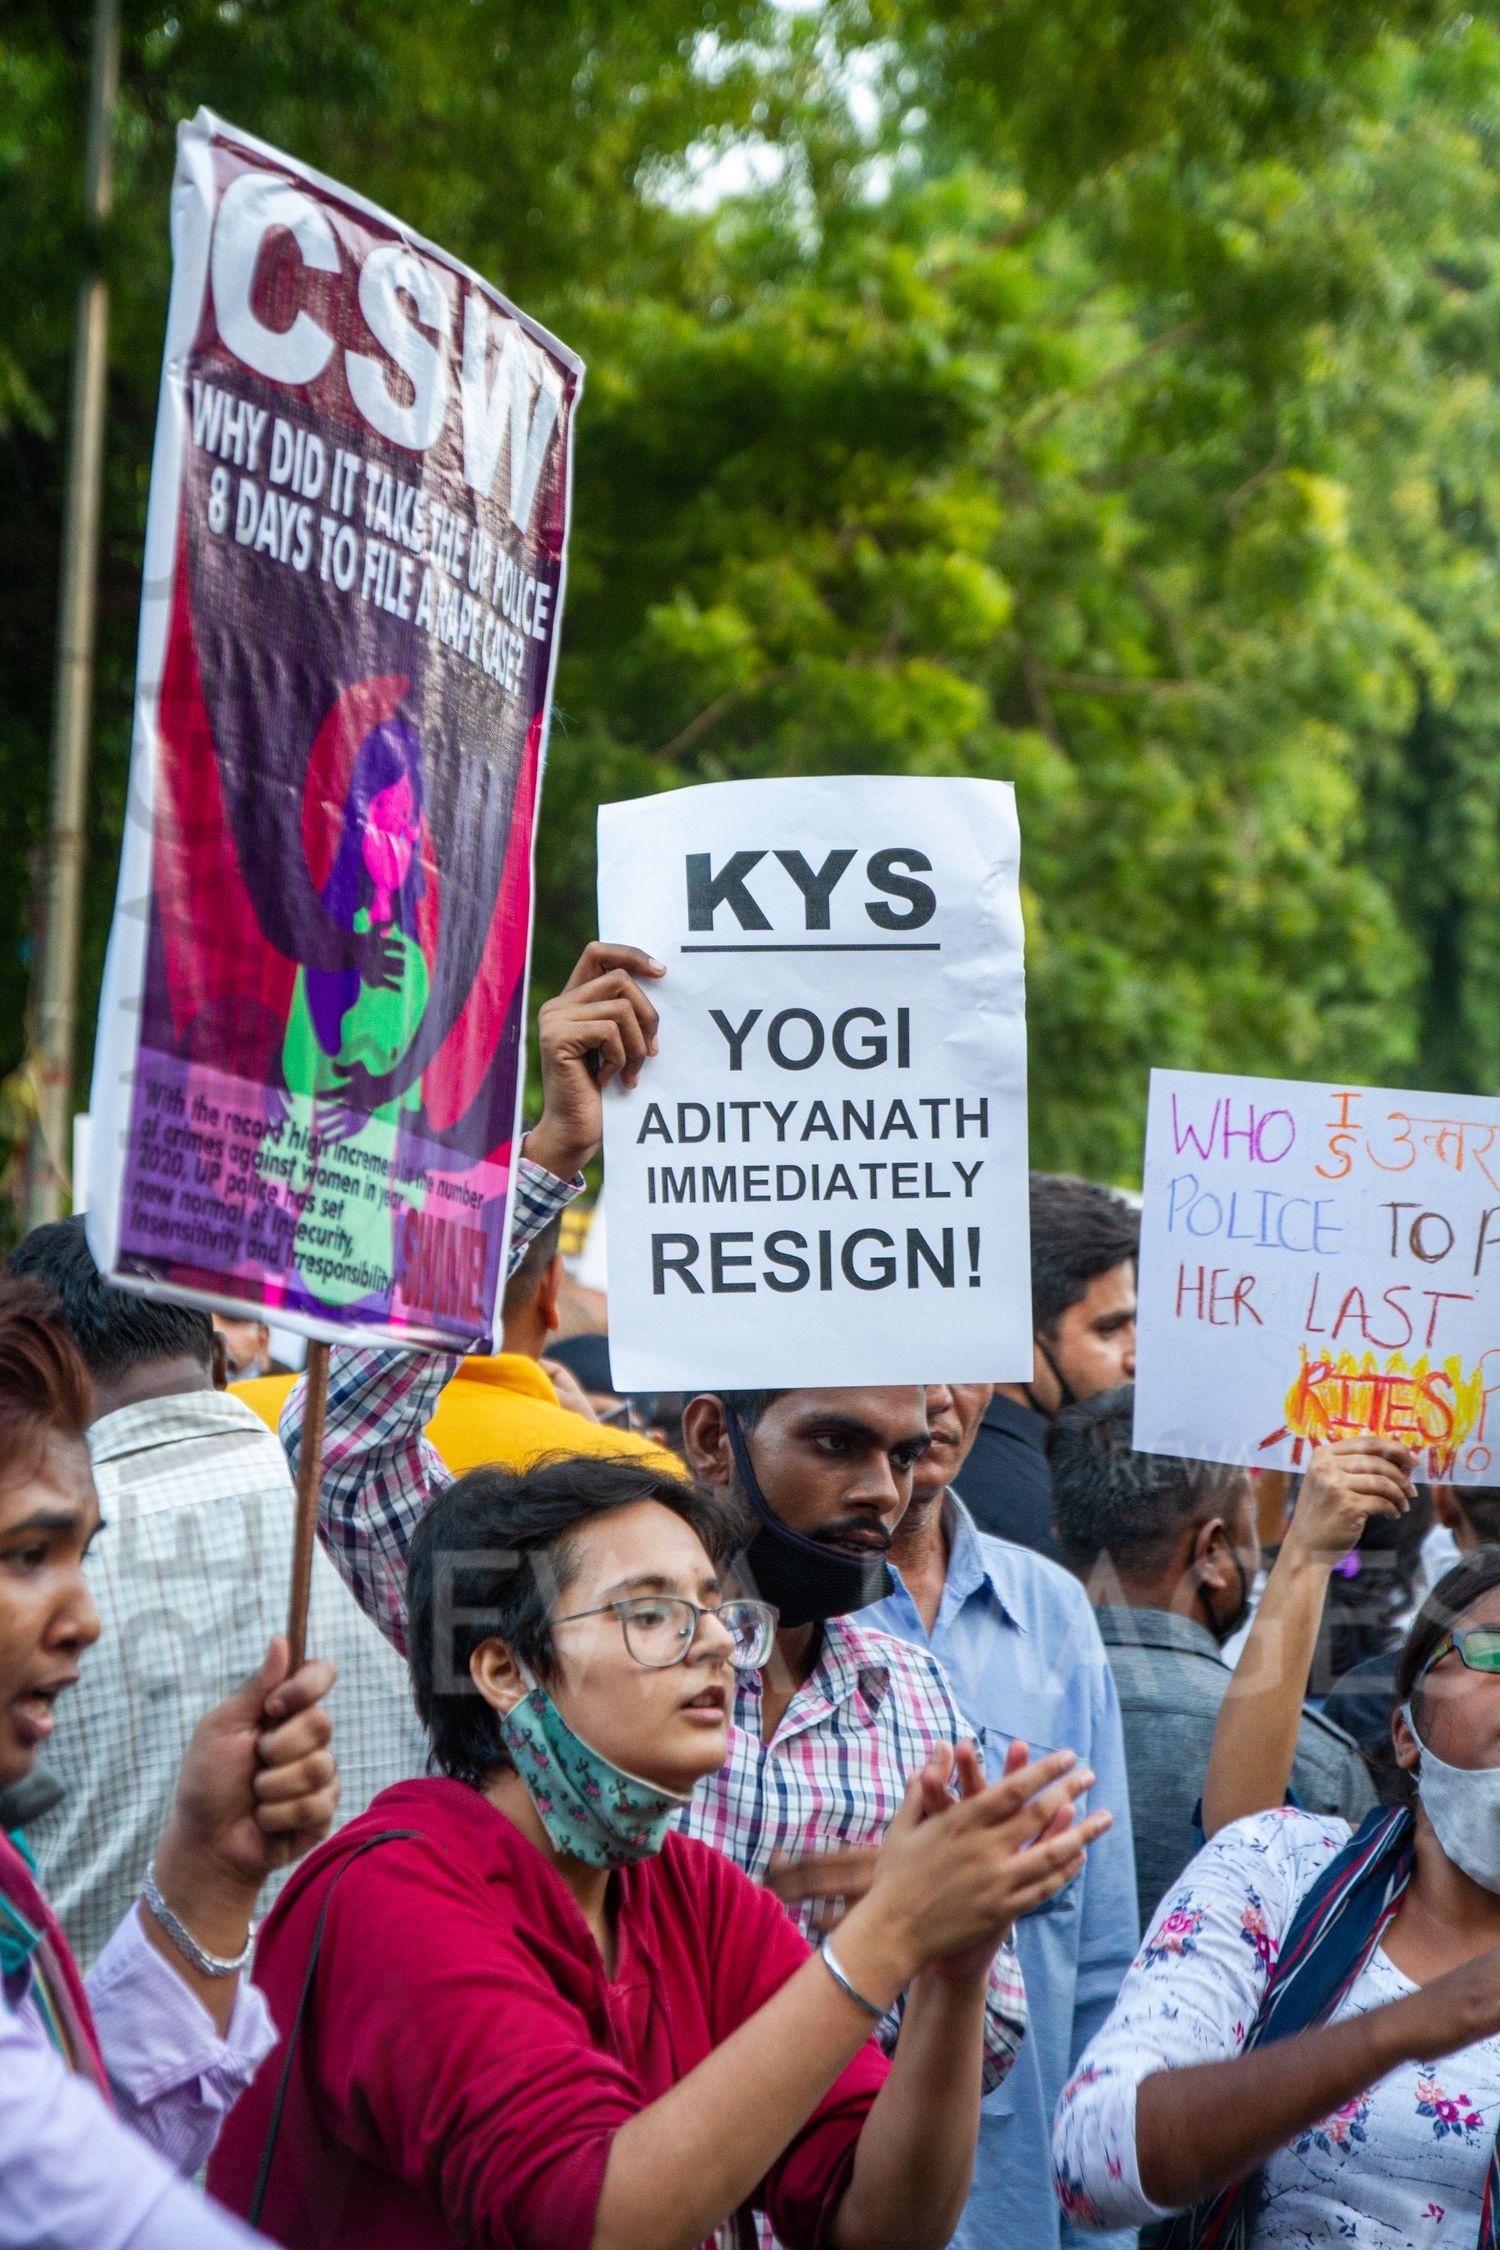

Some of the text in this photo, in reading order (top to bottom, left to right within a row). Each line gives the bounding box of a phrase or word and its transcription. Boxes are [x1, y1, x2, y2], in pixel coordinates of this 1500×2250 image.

[211, 173, 563, 535] CSW
[192, 378, 551, 641] WHY DID IT TAKE THE UP POLICE
[208, 465, 230, 534] 8
[235, 477, 314, 572] DAYS
[320, 516, 358, 592] TO
[361, 536, 415, 621] FILE
[414, 567, 434, 634] A
[433, 579, 482, 664] RAPE
[685, 847, 937, 932] KYS
[709, 1007, 910, 1072] YOGI
[140, 1113, 160, 1138] of
[163, 1122, 224, 1159] crimes
[229, 1142, 297, 1182] against
[302, 1162, 361, 1197] women
[364, 1174, 376, 1201] in
[191, 1095, 219, 1126] the
[288, 1121, 330, 1160] high
[437, 1179, 484, 1211] number
[636, 1097, 989, 1145] ADITYANATH
[1172, 1093, 1296, 1163] WHO
[132, 1179, 174, 1206] new
[180, 1191, 246, 1224] normal
[250, 1203, 268, 1230] of
[195, 1156, 221, 1186] UP
[225, 1170, 278, 1205] police
[286, 1183, 315, 1213] has
[319, 1199, 345, 1221] set
[647, 1161, 985, 1204] IMMEDIATELY
[1168, 1173, 1344, 1255] POLICE
[1378, 1201, 1456, 1264] TO
[247, 1237, 281, 1266] and
[651, 1226, 982, 1296] RESIGN!
[1175, 1260, 1475, 1350] HER LAST
